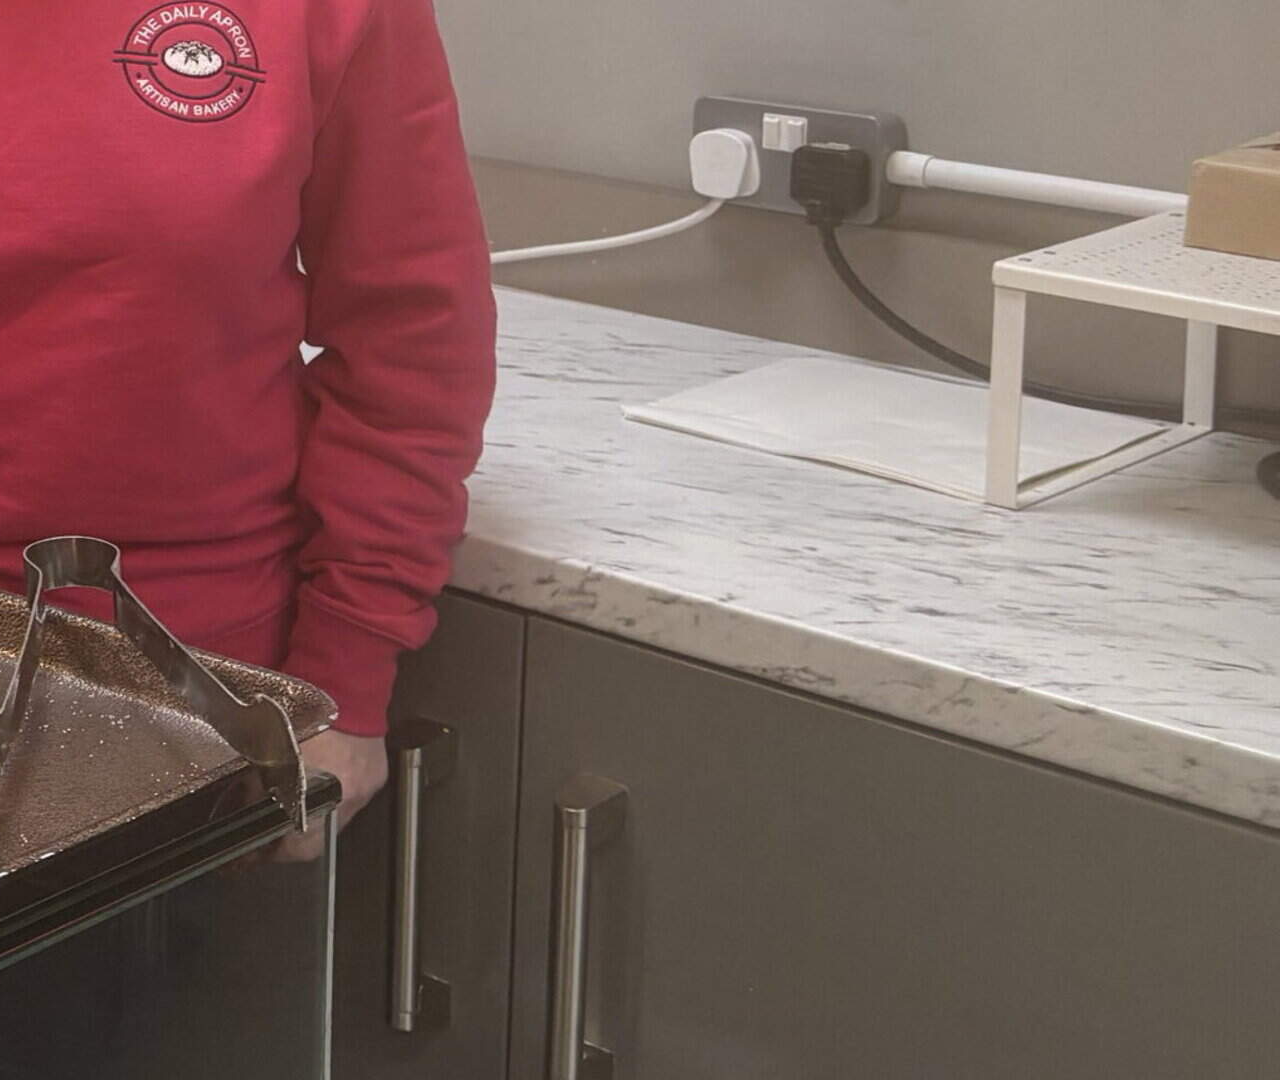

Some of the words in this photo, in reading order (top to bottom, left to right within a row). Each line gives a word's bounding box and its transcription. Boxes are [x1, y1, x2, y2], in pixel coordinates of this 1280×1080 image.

[133, 17, 162, 46] THE
[159, 5, 209, 24] DAILY
[209, 9, 252, 59] APRON
[135, 78, 189, 116] ARTISAN
[193, 89, 241, 116] BAKERY
